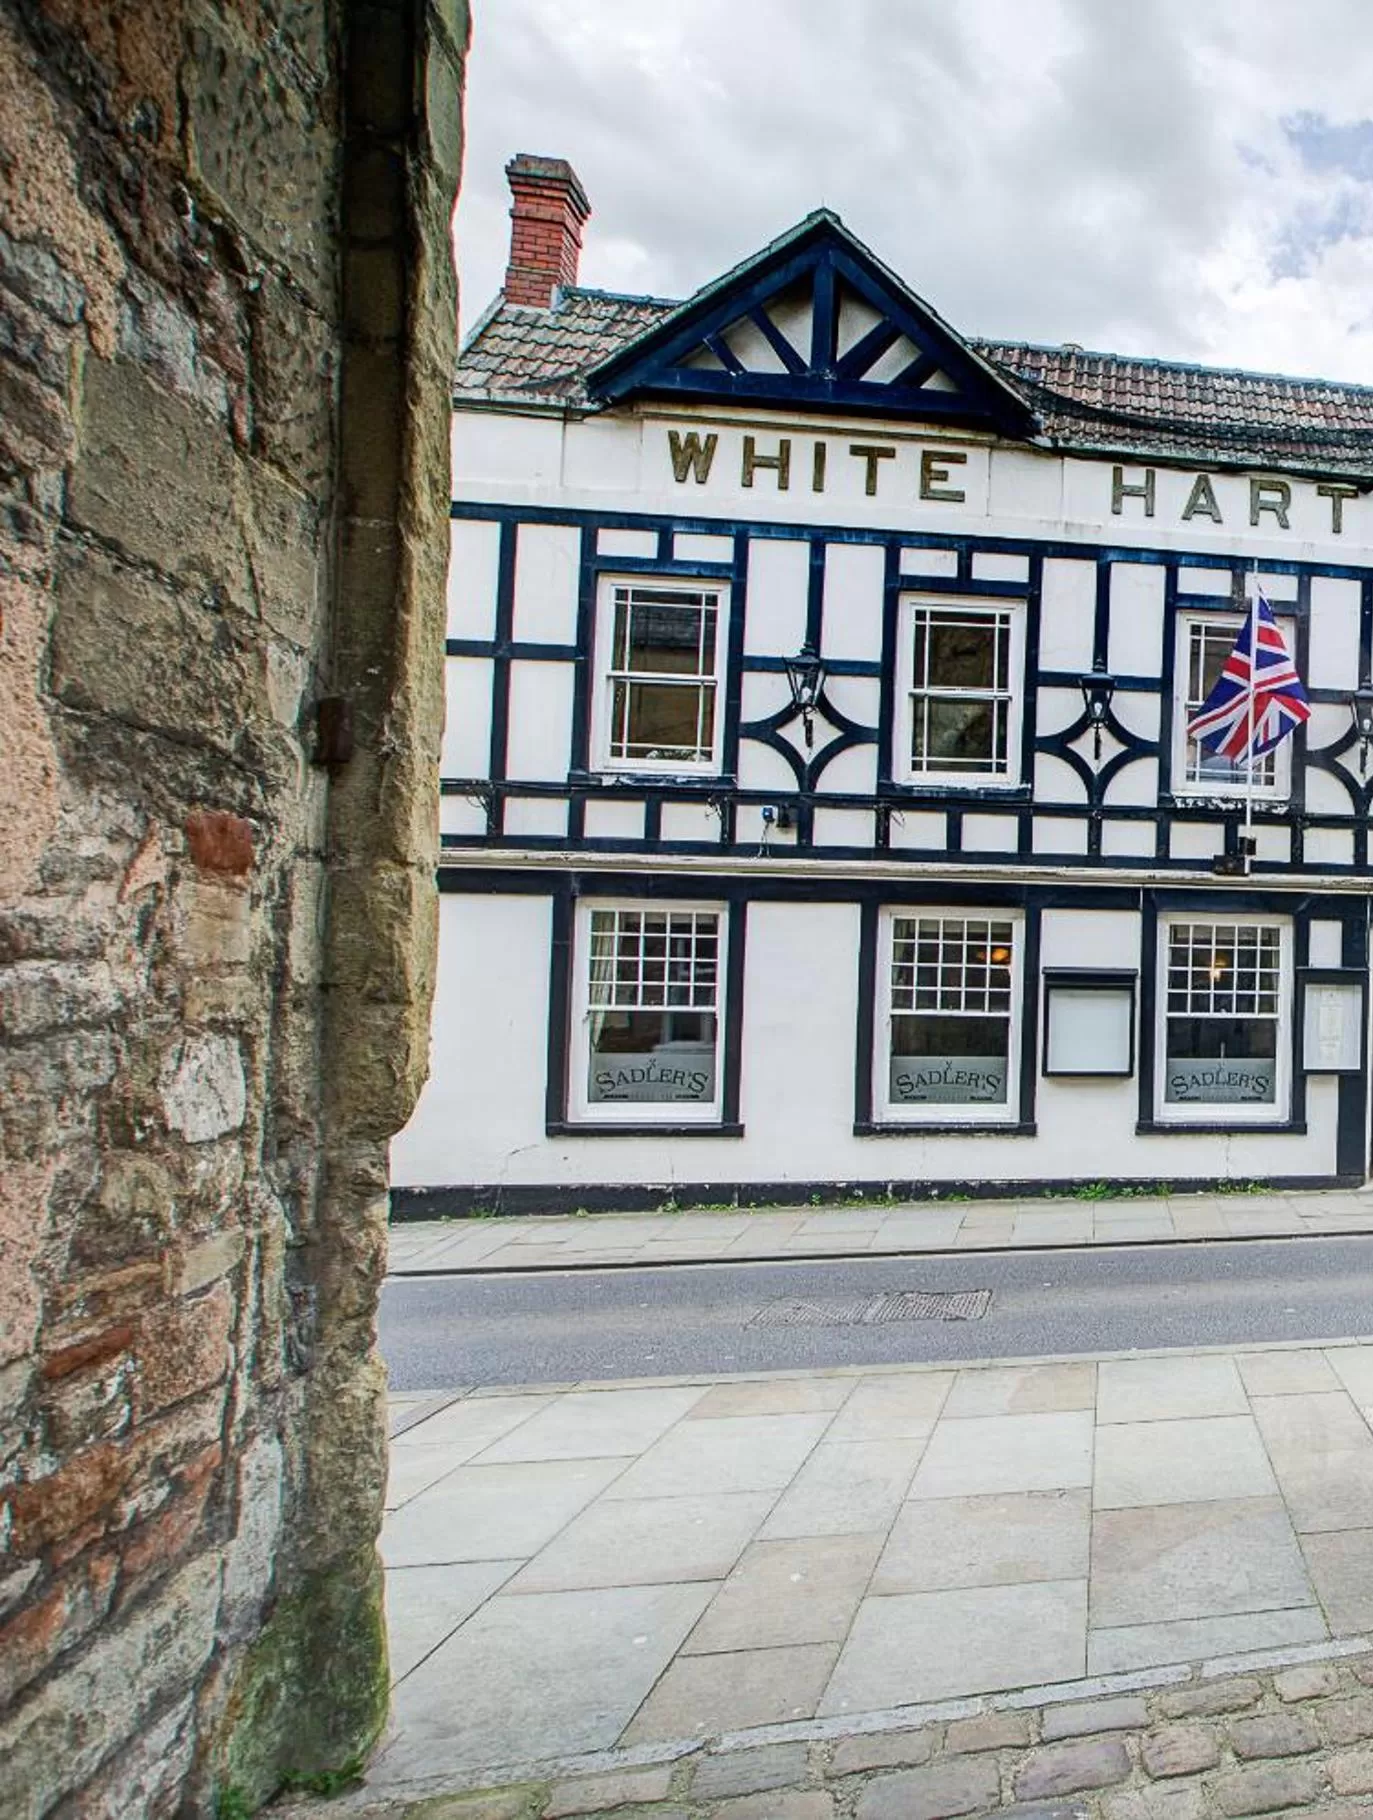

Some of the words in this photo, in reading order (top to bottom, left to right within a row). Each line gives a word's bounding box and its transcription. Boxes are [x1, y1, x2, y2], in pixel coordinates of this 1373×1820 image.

[667, 429, 968, 503] WHITE
[1110, 465, 1360, 534] HART
[595, 1067, 709, 1094] SADLER'S
[896, 1070, 1001, 1095] SADLER'S
[1171, 1071, 1269, 1095] SADLER'S
